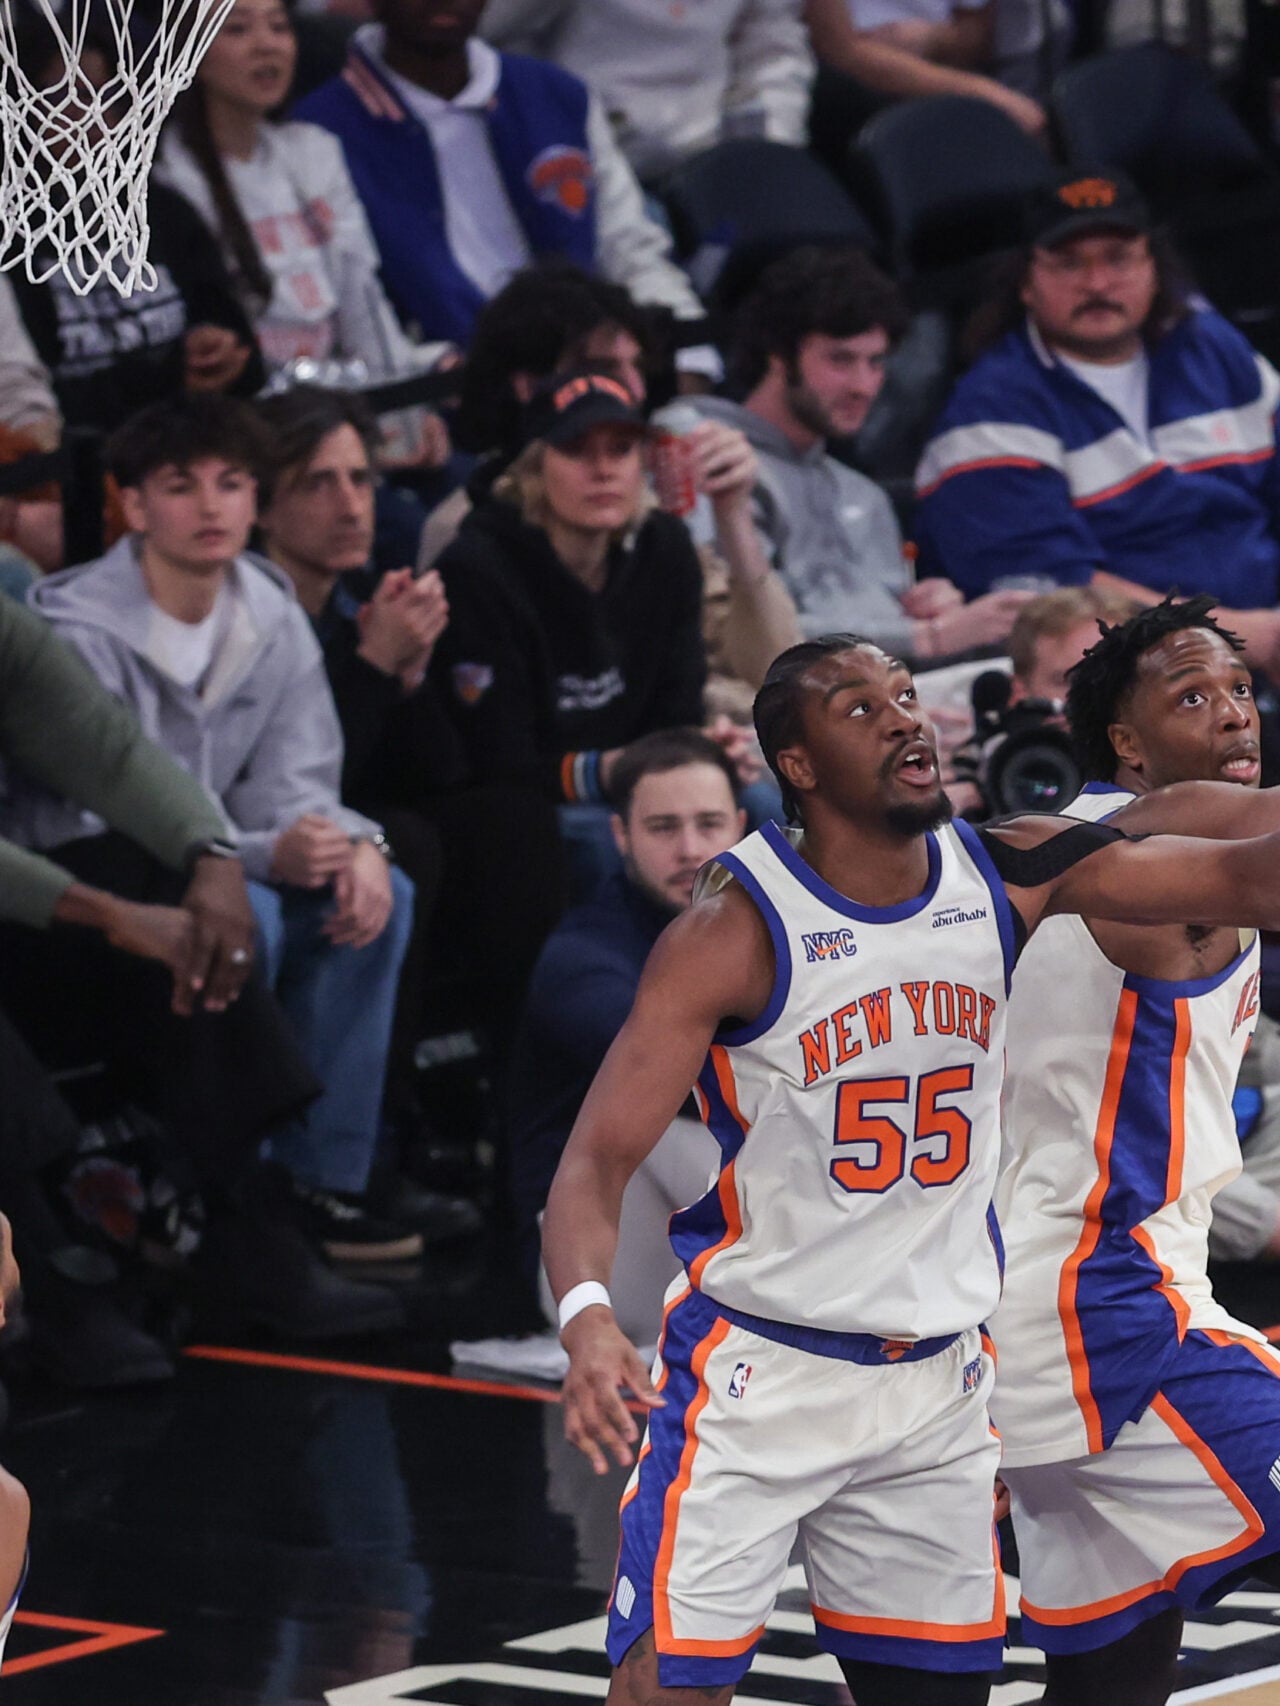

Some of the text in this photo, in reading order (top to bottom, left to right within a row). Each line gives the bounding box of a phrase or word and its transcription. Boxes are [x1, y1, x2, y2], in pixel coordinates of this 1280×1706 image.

[801, 928, 858, 963] NYC
[932, 906, 987, 928] abu dhabi
[798, 981, 996, 1087] NEW YORK
[830, 1063, 975, 1194] 55
